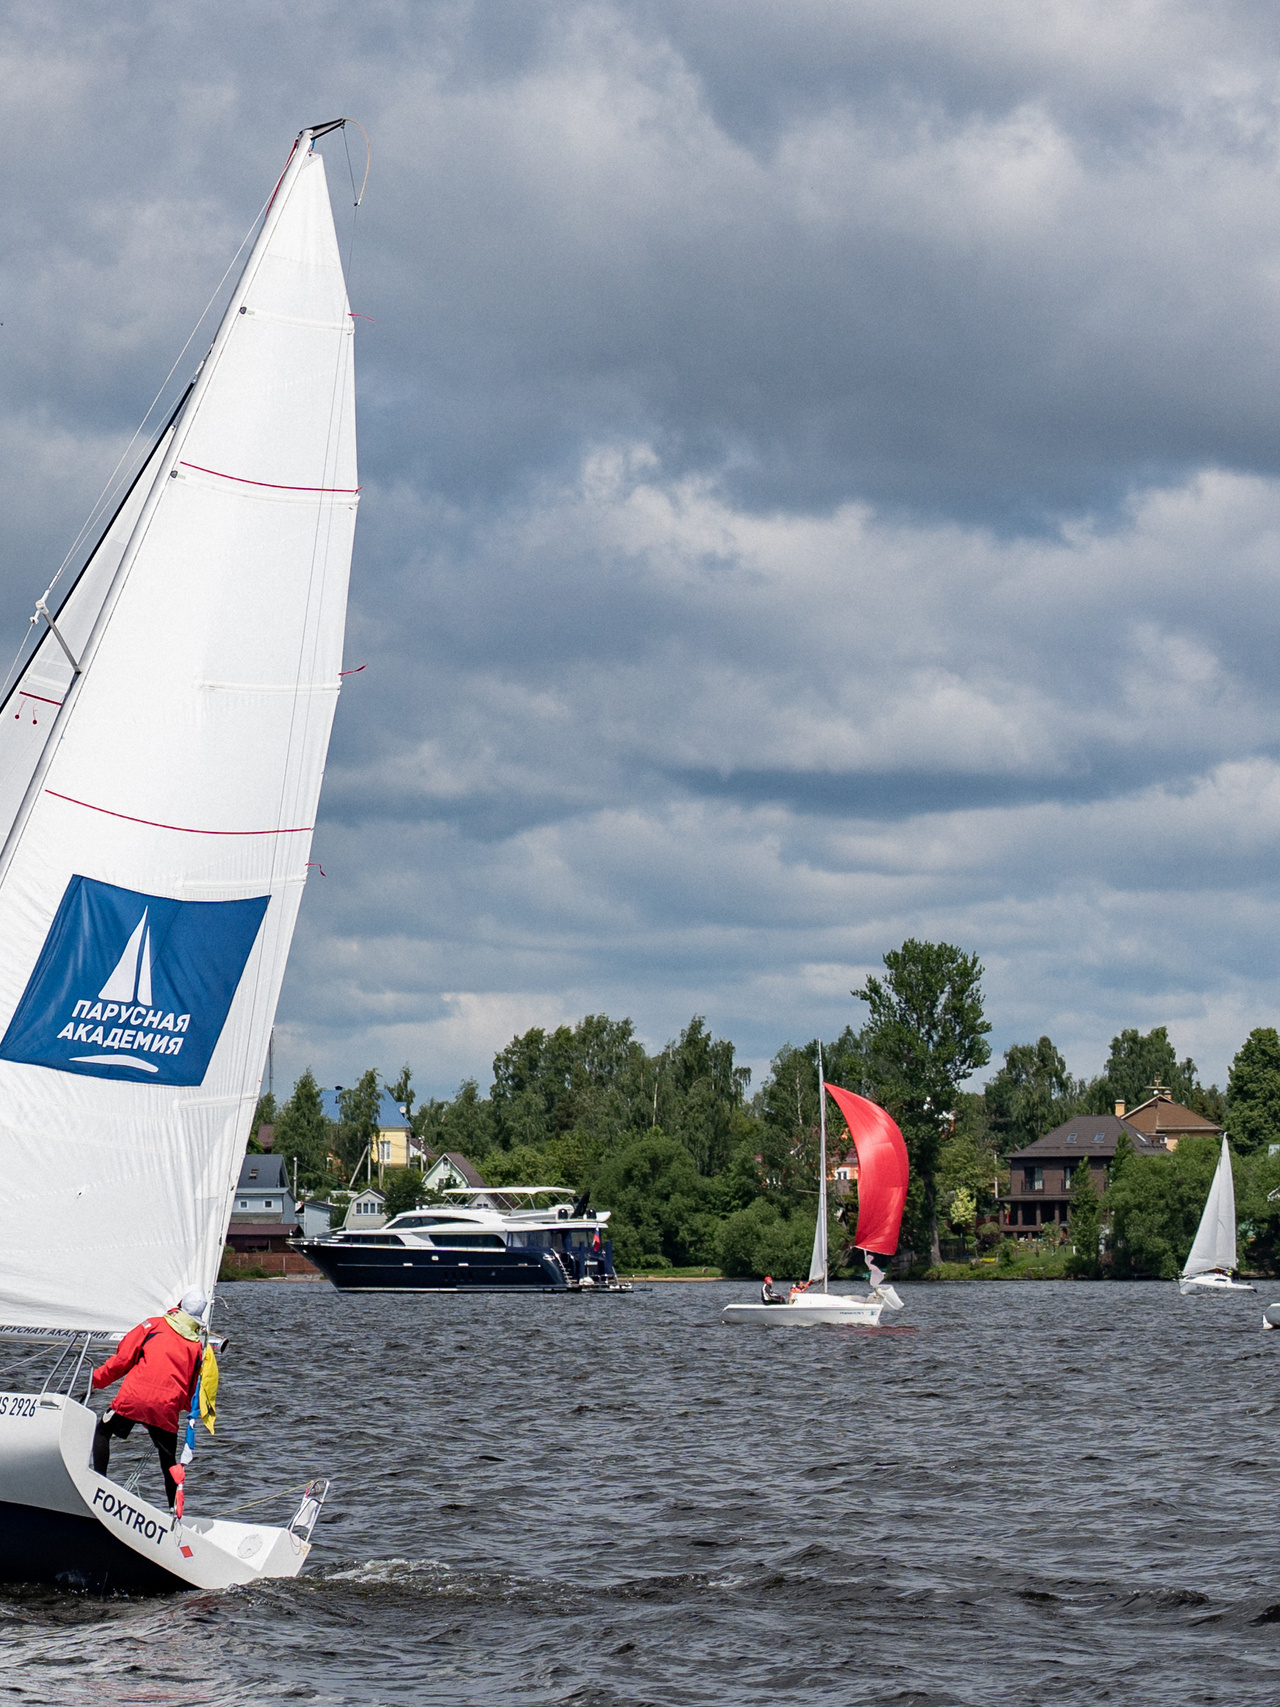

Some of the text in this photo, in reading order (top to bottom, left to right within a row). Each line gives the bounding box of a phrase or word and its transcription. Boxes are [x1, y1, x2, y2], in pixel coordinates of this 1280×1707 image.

[71, 999, 191, 1033] ПАРУСНАЯ
[56, 1021, 184, 1055] АКАДЕМИЯ
[9, 1397, 38, 1418] 2926
[92, 1486, 169, 1545] FOXTROT
